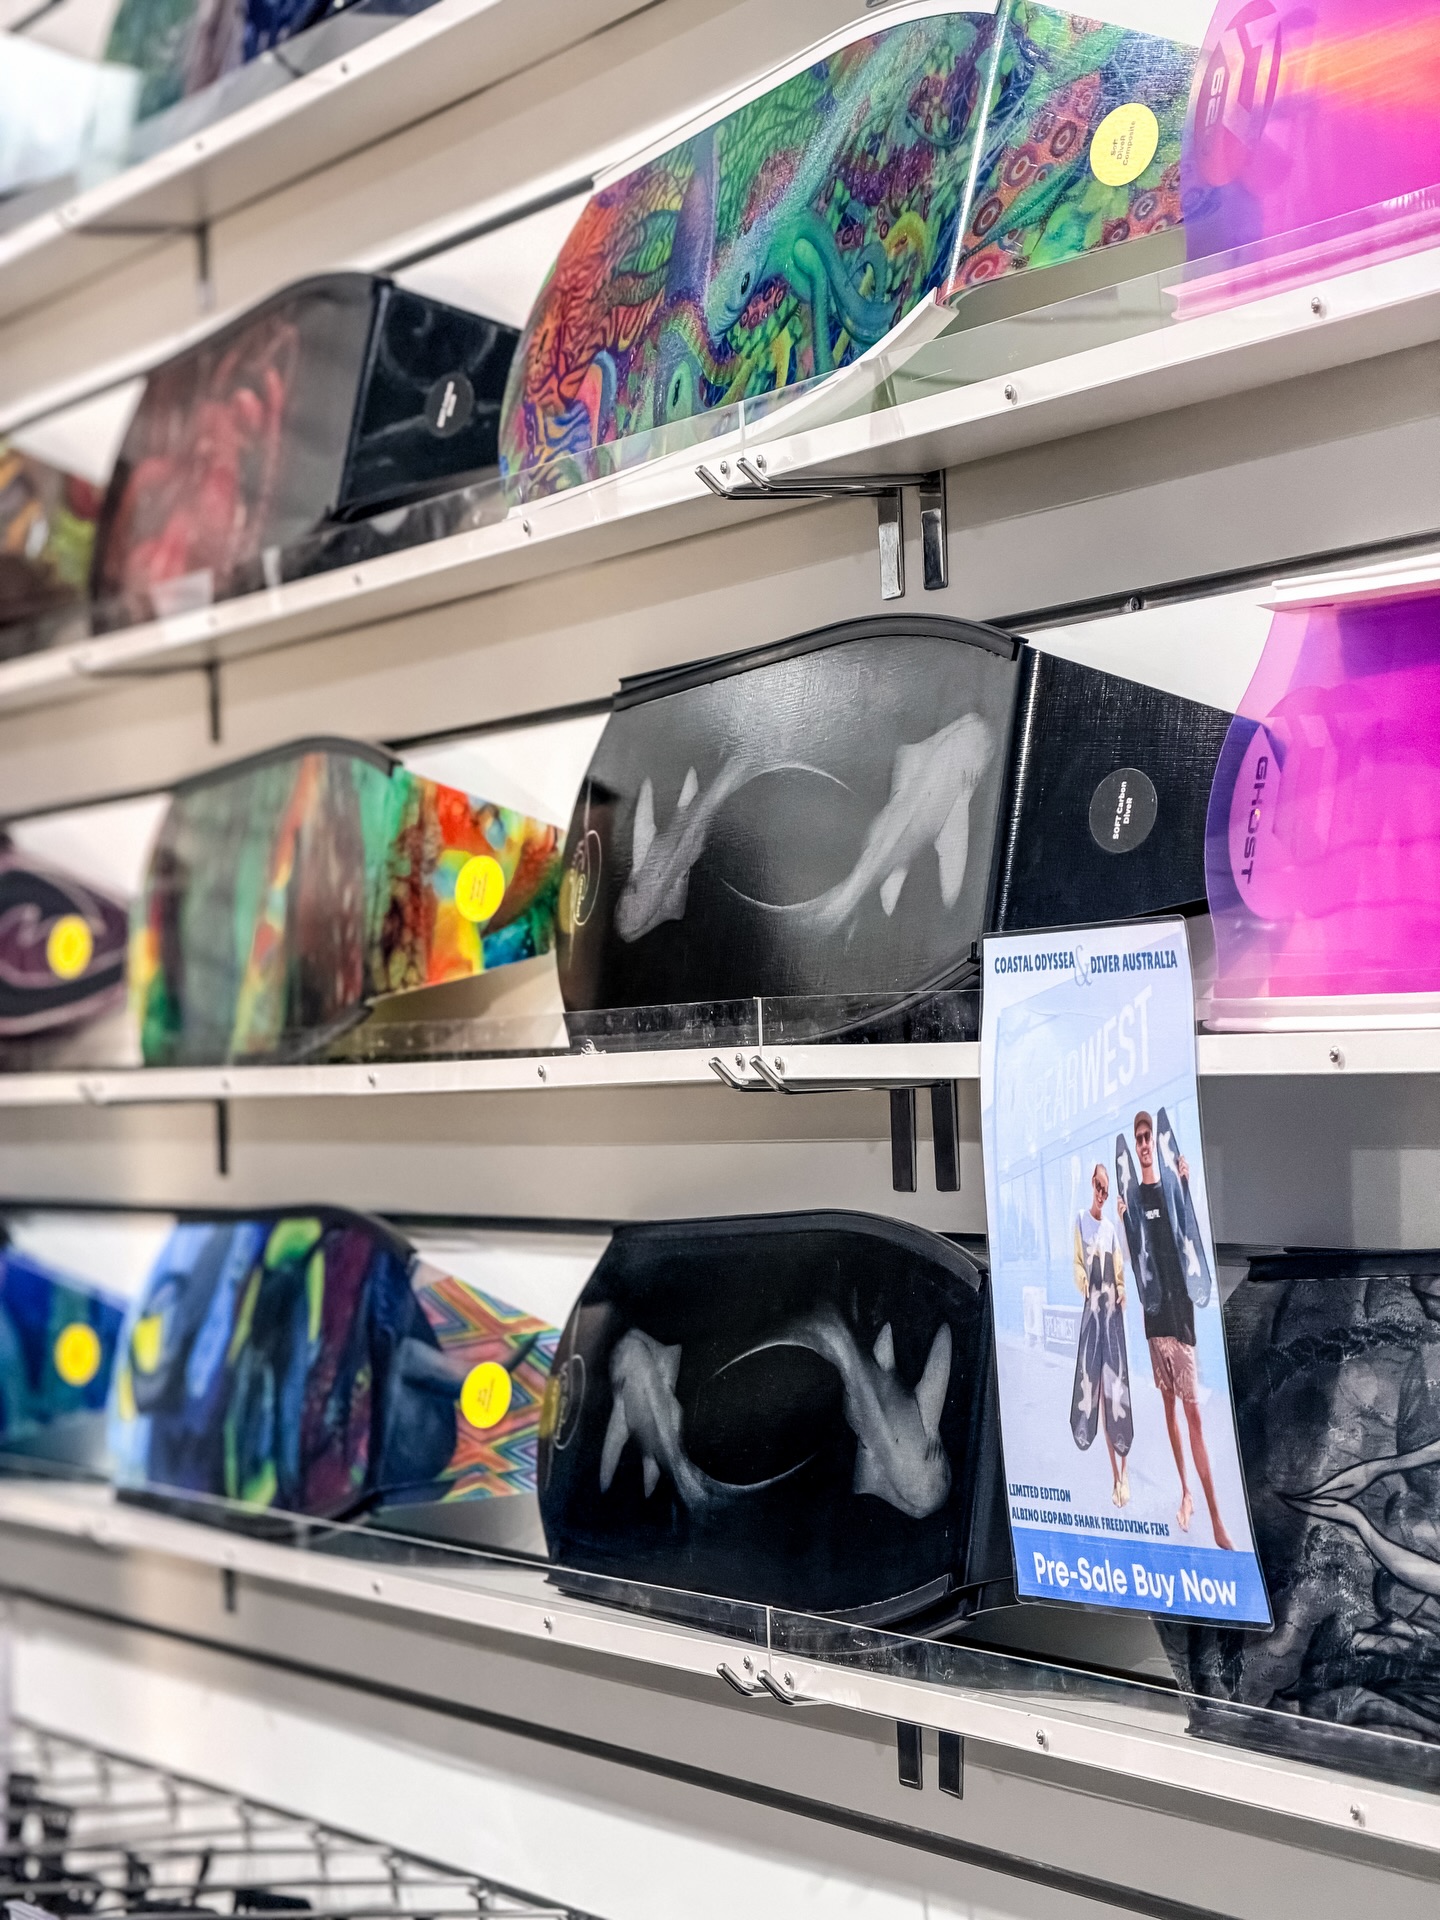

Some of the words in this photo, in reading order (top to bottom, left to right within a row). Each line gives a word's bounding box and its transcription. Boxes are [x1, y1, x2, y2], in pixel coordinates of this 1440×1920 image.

[1112, 815, 1121, 840] SOFT
[1117, 781, 1127, 814] Carbon
[1123, 797, 1133, 824] DiveR
[1241, 755, 1268, 884] GHOST
[994, 954, 1034, 974] COASTAL
[1034, 951, 1076, 971] ODYSSEA
[1074, 944, 1092, 987] &
[1090, 954, 1120, 974] DIVER
[1122, 949, 1178, 972] AUSTRALIA
[1008, 1483, 1039, 1499] LIMITED
[1040, 1486, 1071, 1502] EDITION
[1011, 1506, 1039, 1523] ALBINO
[1040, 1509, 1073, 1526] LEOPARD
[1074, 1513, 1101, 1529] SHARK
[1101, 1517, 1150, 1535] FREEDIVING
[1150, 1522, 1170, 1537] FINS
[1033, 1551, 1128, 1594] Pre-Sale
[1132, 1563, 1175, 1607] Buy
[1181, 1568, 1237, 1606] Now
